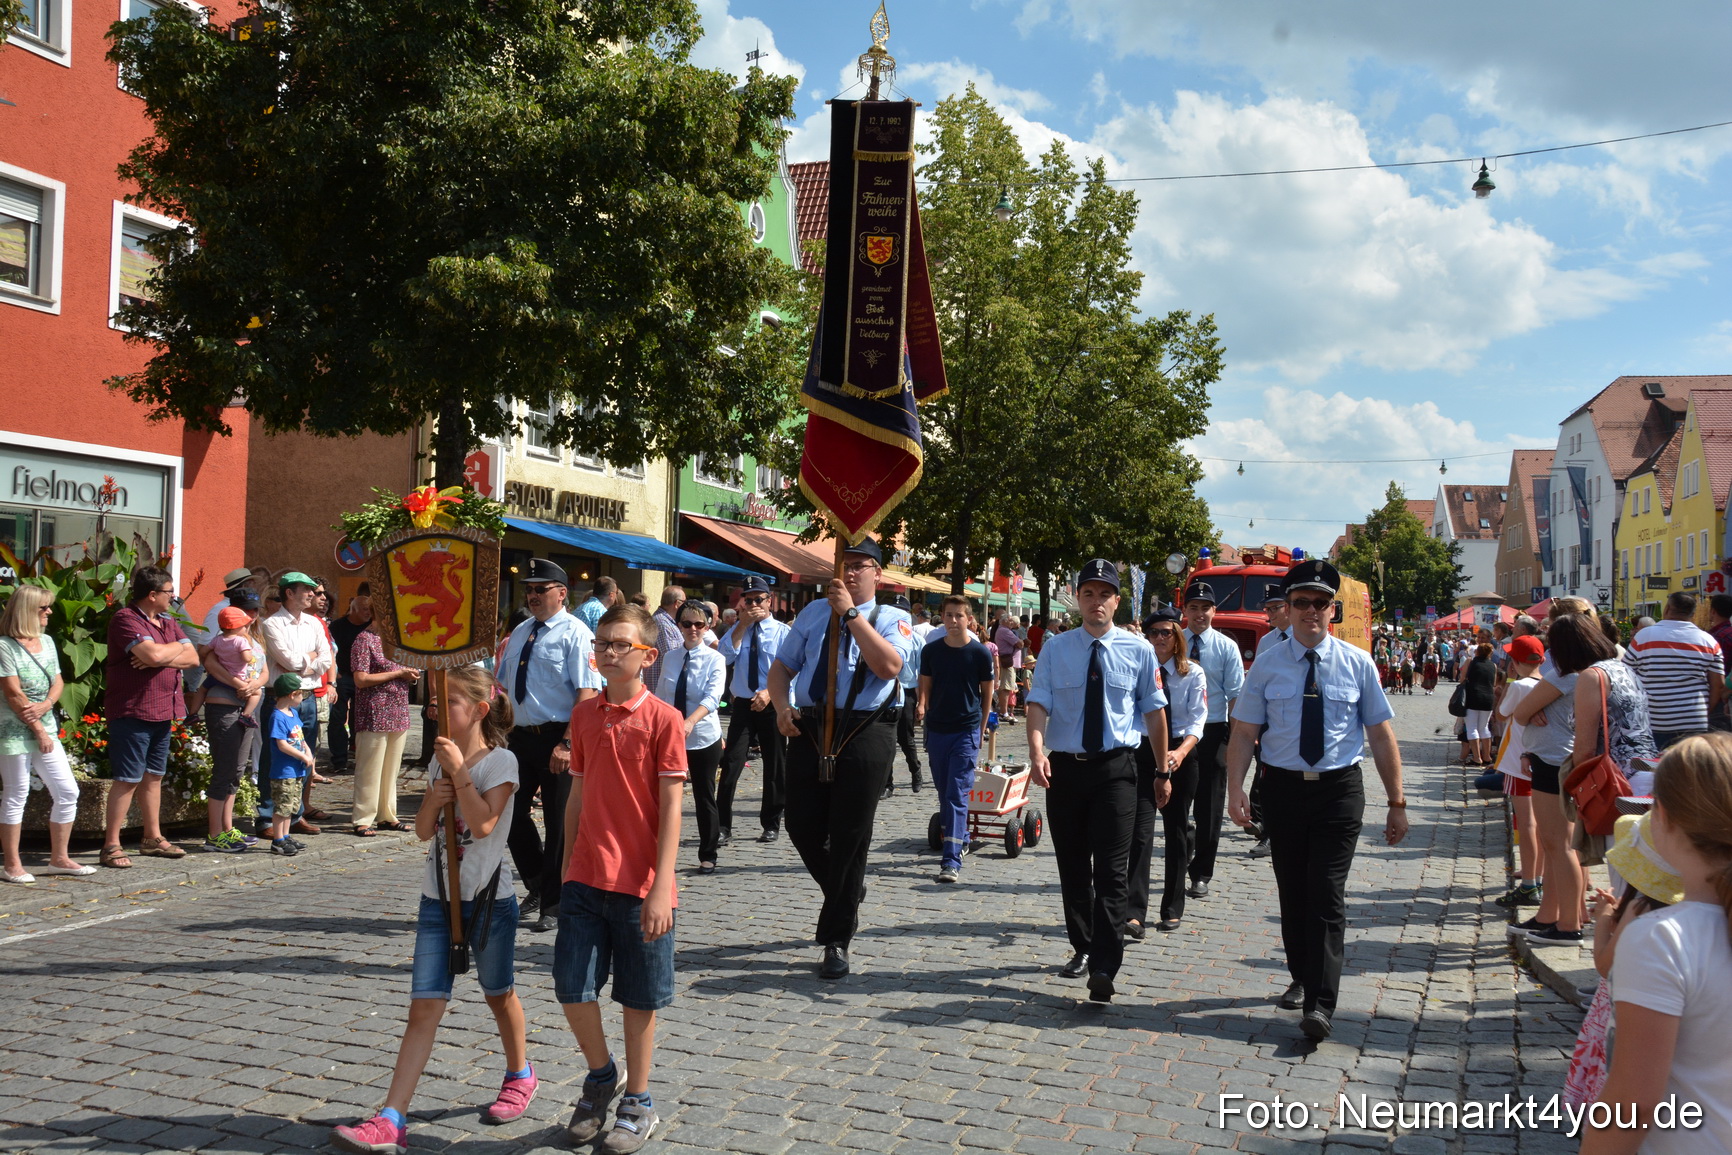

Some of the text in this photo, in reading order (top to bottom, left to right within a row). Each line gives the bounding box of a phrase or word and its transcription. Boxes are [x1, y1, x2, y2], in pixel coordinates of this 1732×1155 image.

[873, 176, 892, 186] Zur
[867, 205, 898, 217] weihe
[859, 328, 890, 341] Velburg
[507, 480, 630, 523] STADT APOTHEKE
[968, 789, 995, 803] 112
